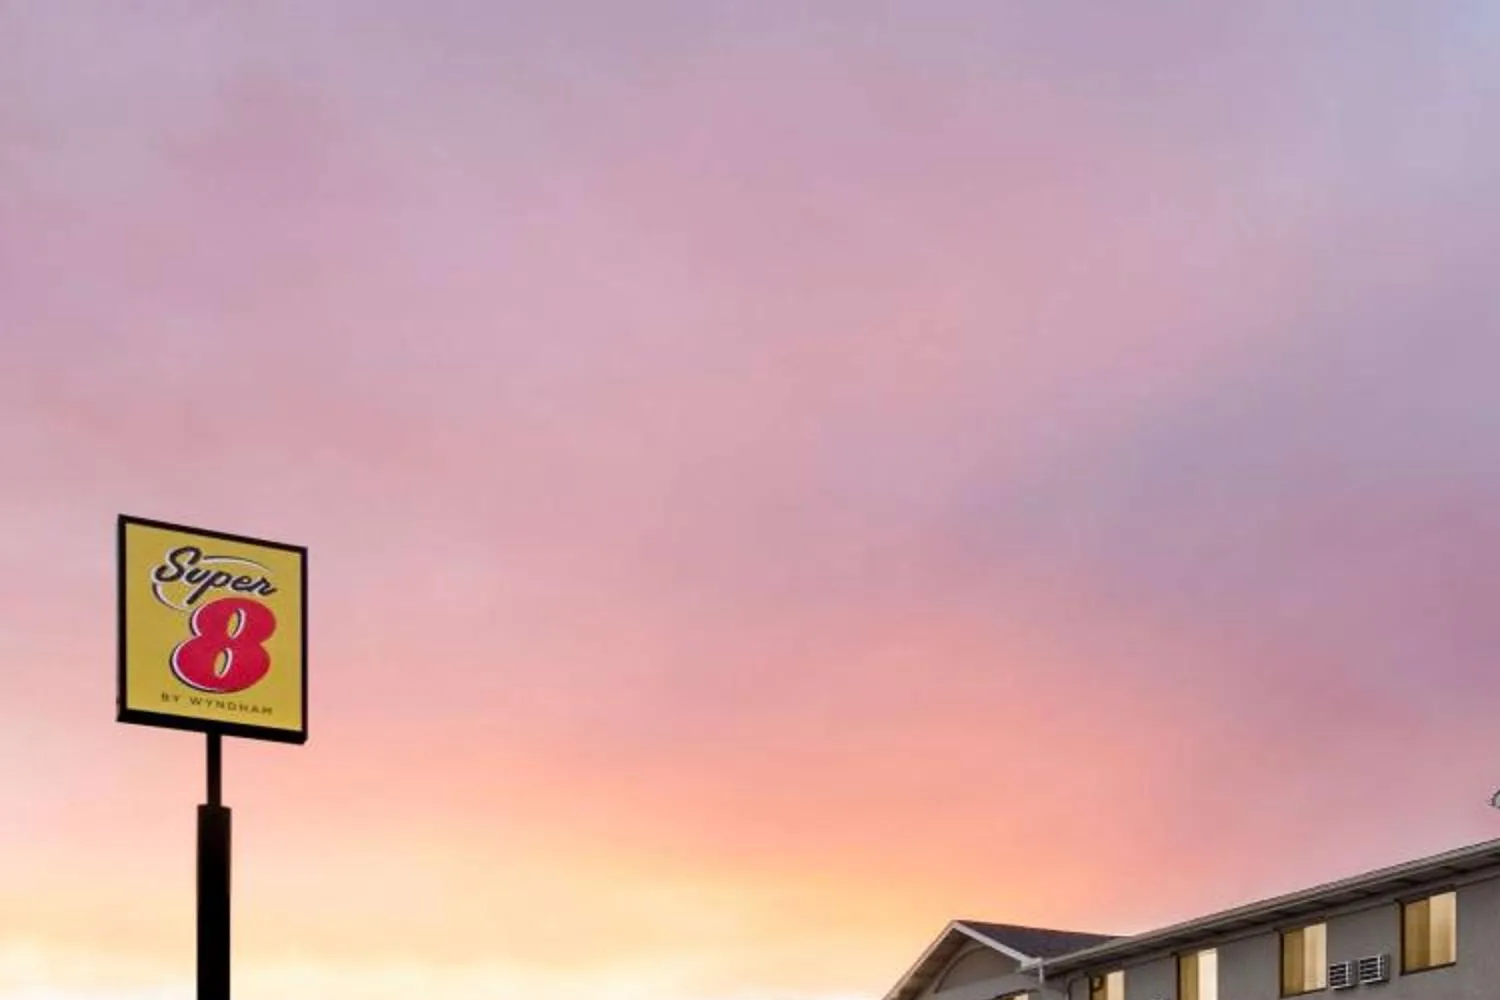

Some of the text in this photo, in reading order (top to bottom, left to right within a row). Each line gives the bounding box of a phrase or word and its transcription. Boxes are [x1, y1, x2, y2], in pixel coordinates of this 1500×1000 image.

[154, 546, 276, 605] Super
[169, 597, 276, 694] 8
[161, 692, 273, 715] BY WYNDHAM
